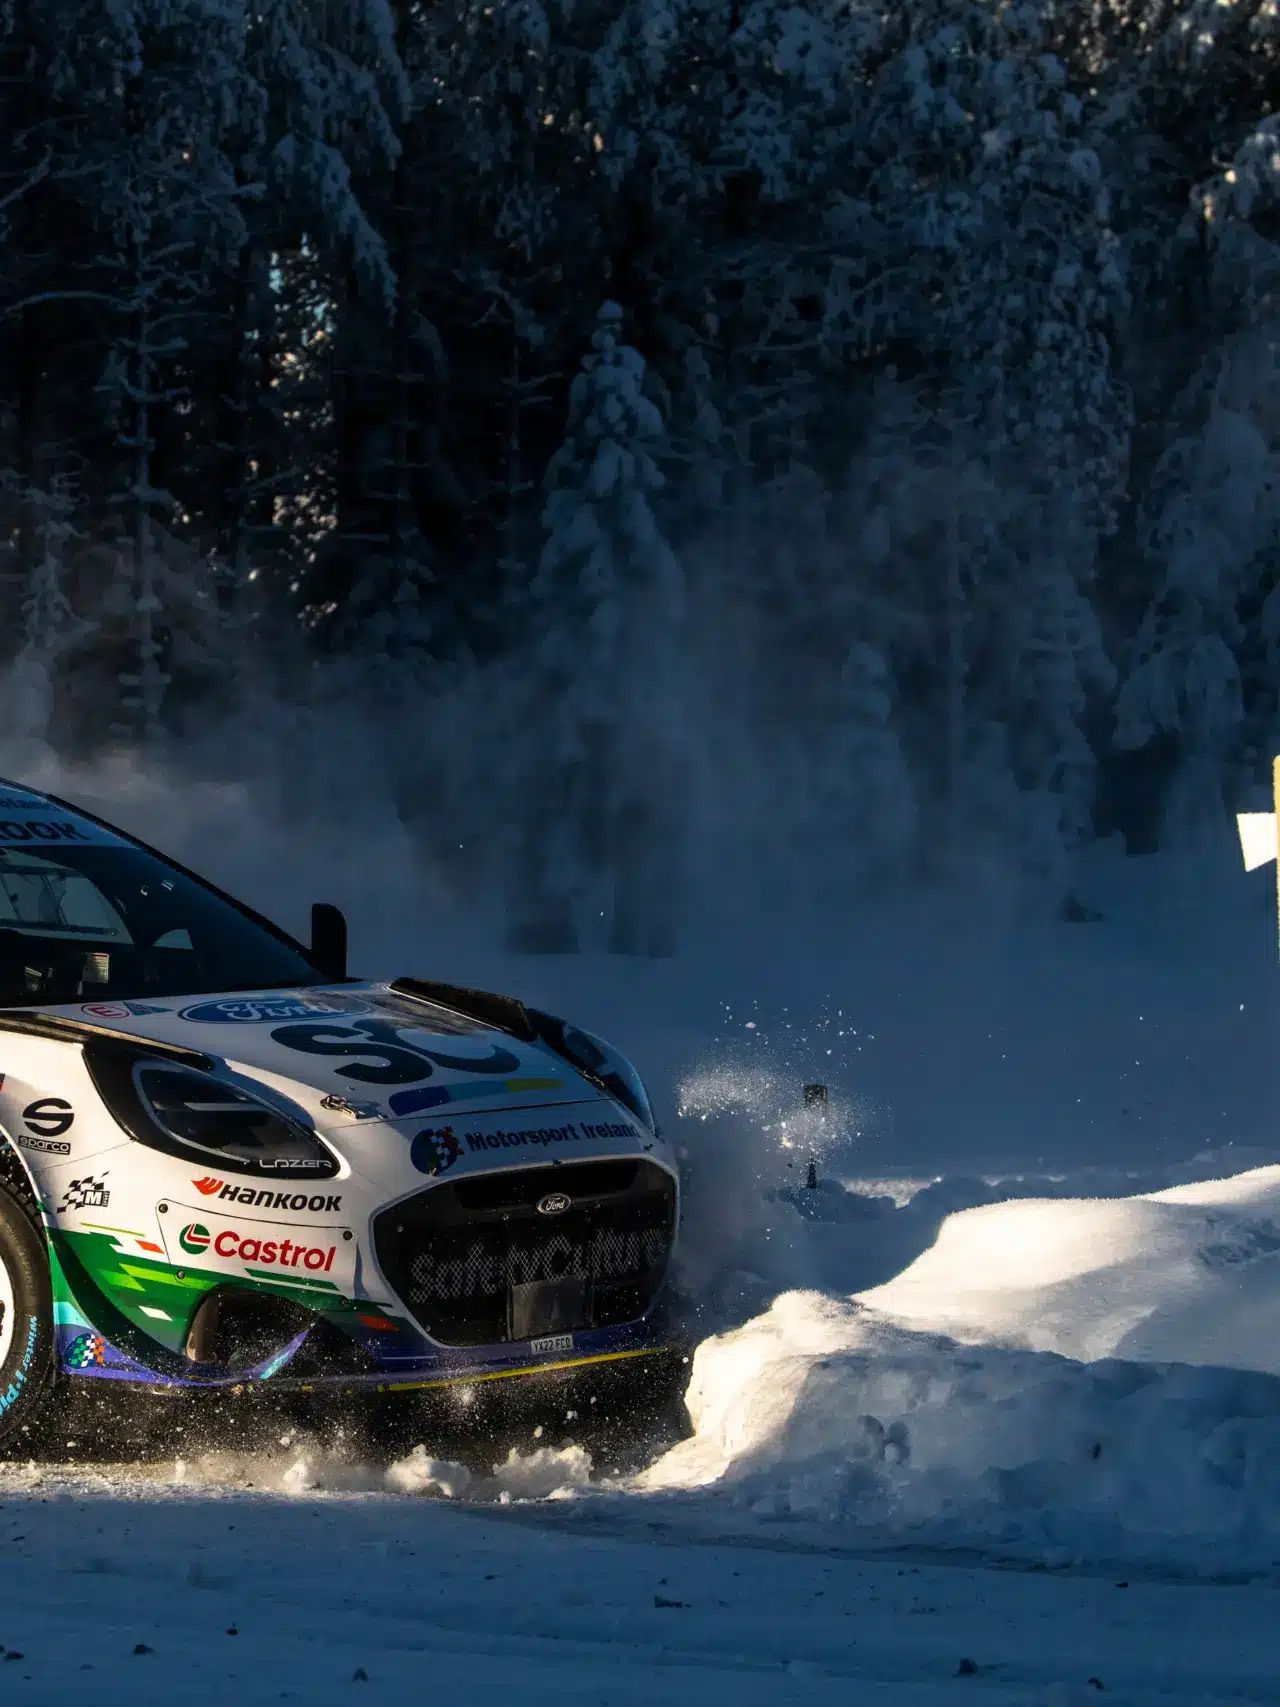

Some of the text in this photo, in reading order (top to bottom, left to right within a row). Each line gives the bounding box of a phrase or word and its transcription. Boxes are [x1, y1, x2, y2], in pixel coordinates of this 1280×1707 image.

[215, 999, 349, 1021] Ford
[270, 1019, 522, 1085] SC
[19, 1136, 70, 1153] sparco
[464, 1122, 578, 1152] Motorsport
[259, 1158, 333, 1169] LAZER
[545, 1196, 566, 1212] Ford
[214, 1230, 337, 1272] Castrol
[533, 1338, 556, 1353] YX22
